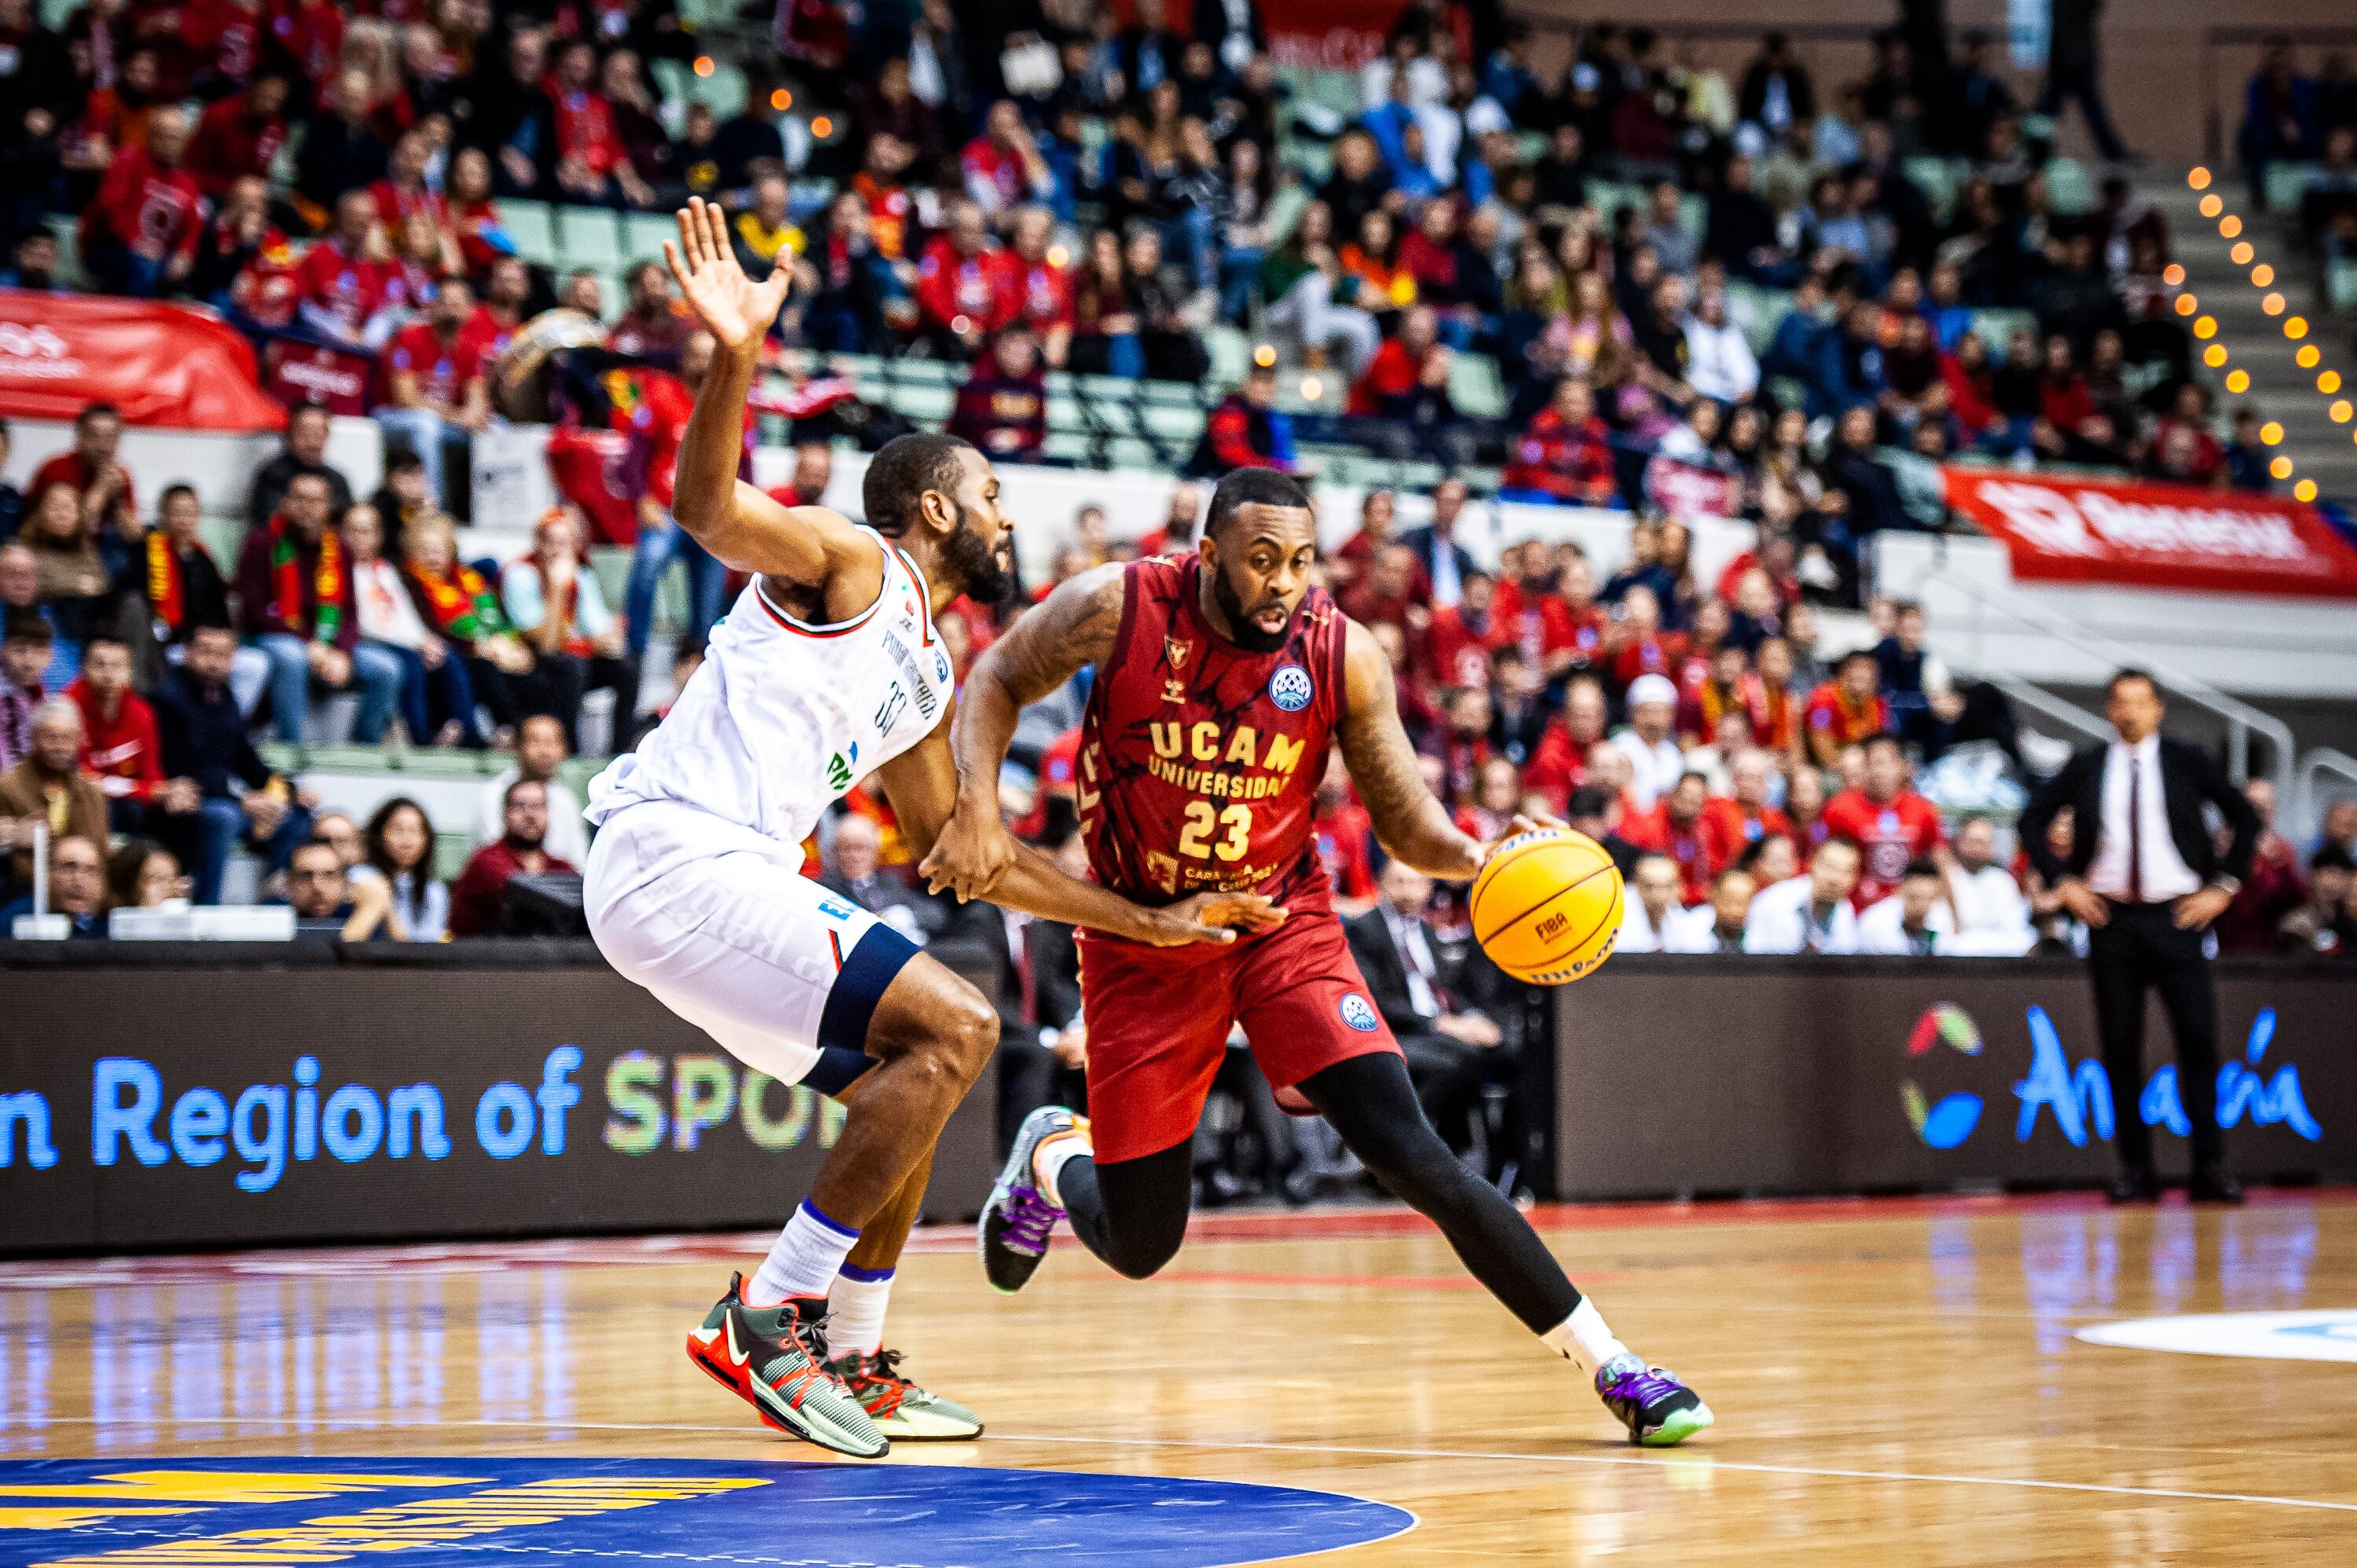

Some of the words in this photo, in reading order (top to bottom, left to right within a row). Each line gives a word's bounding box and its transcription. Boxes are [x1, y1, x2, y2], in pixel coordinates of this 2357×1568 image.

[1149, 720, 1306, 775] UCAM
[1178, 800, 1253, 862] 23
[1535, 911, 1568, 940] FIBA
[91, 1053, 453, 1192] Region
[475, 1044, 584, 1160] of
